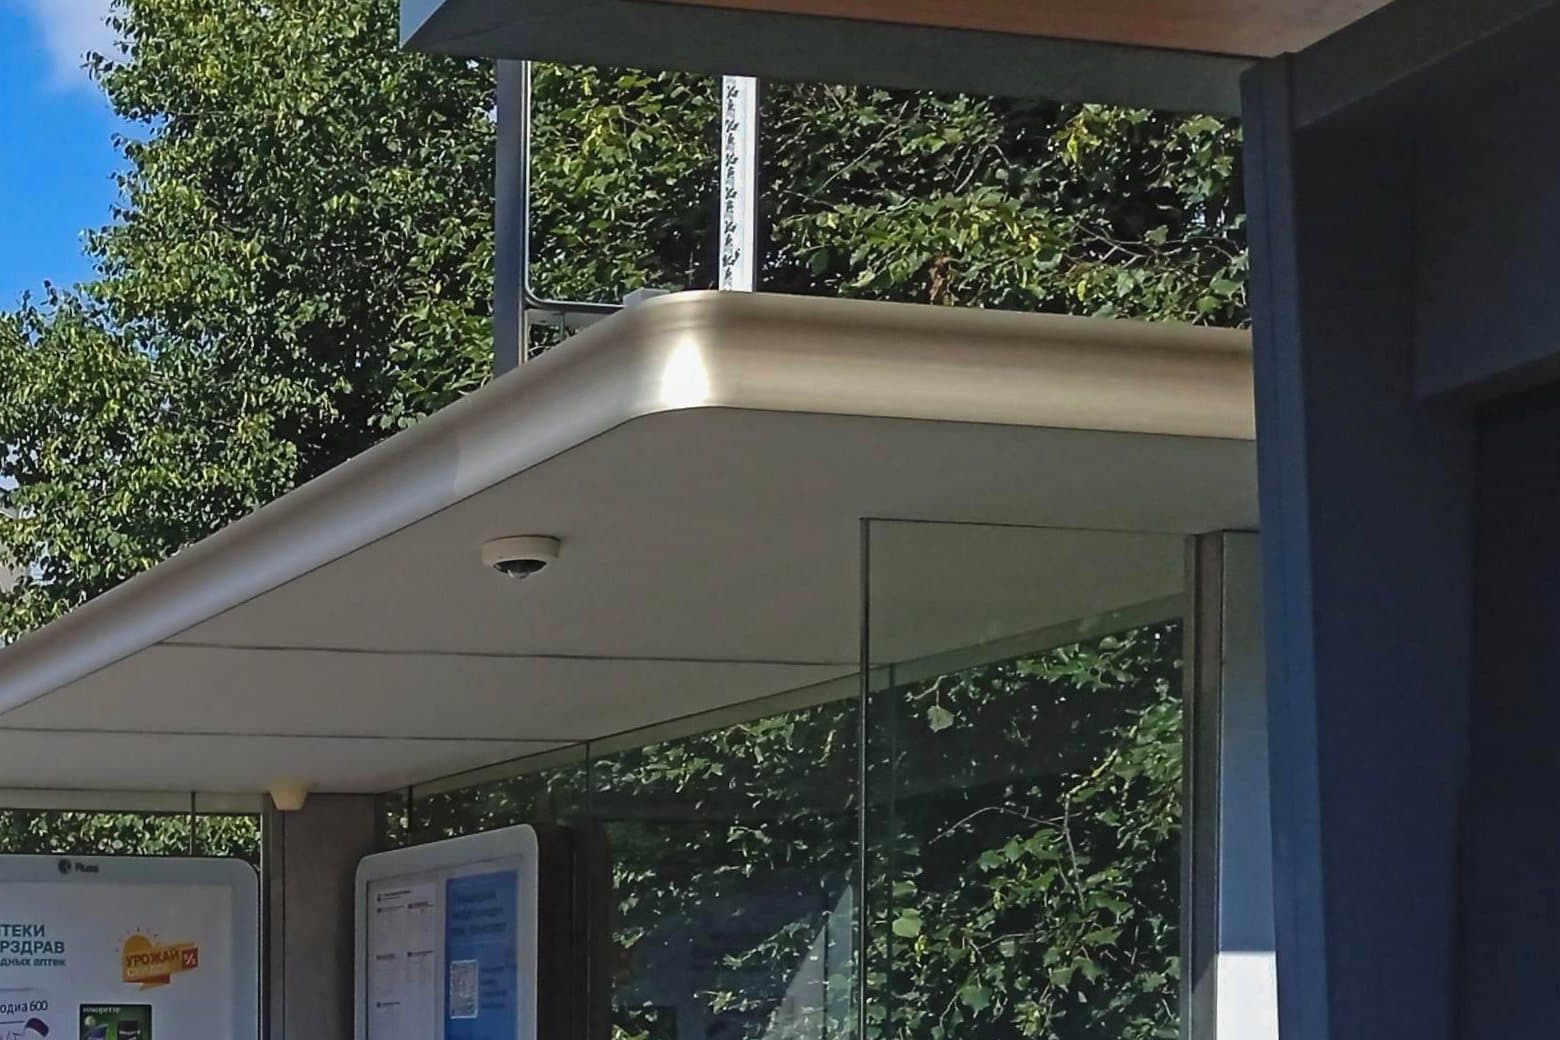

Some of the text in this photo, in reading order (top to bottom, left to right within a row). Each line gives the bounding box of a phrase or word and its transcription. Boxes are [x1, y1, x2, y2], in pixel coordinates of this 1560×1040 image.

[33, 958, 65, 966] аптек
[126, 948, 179, 967] УРОЖАЙ
[29, 1000, 48, 1011] 600
